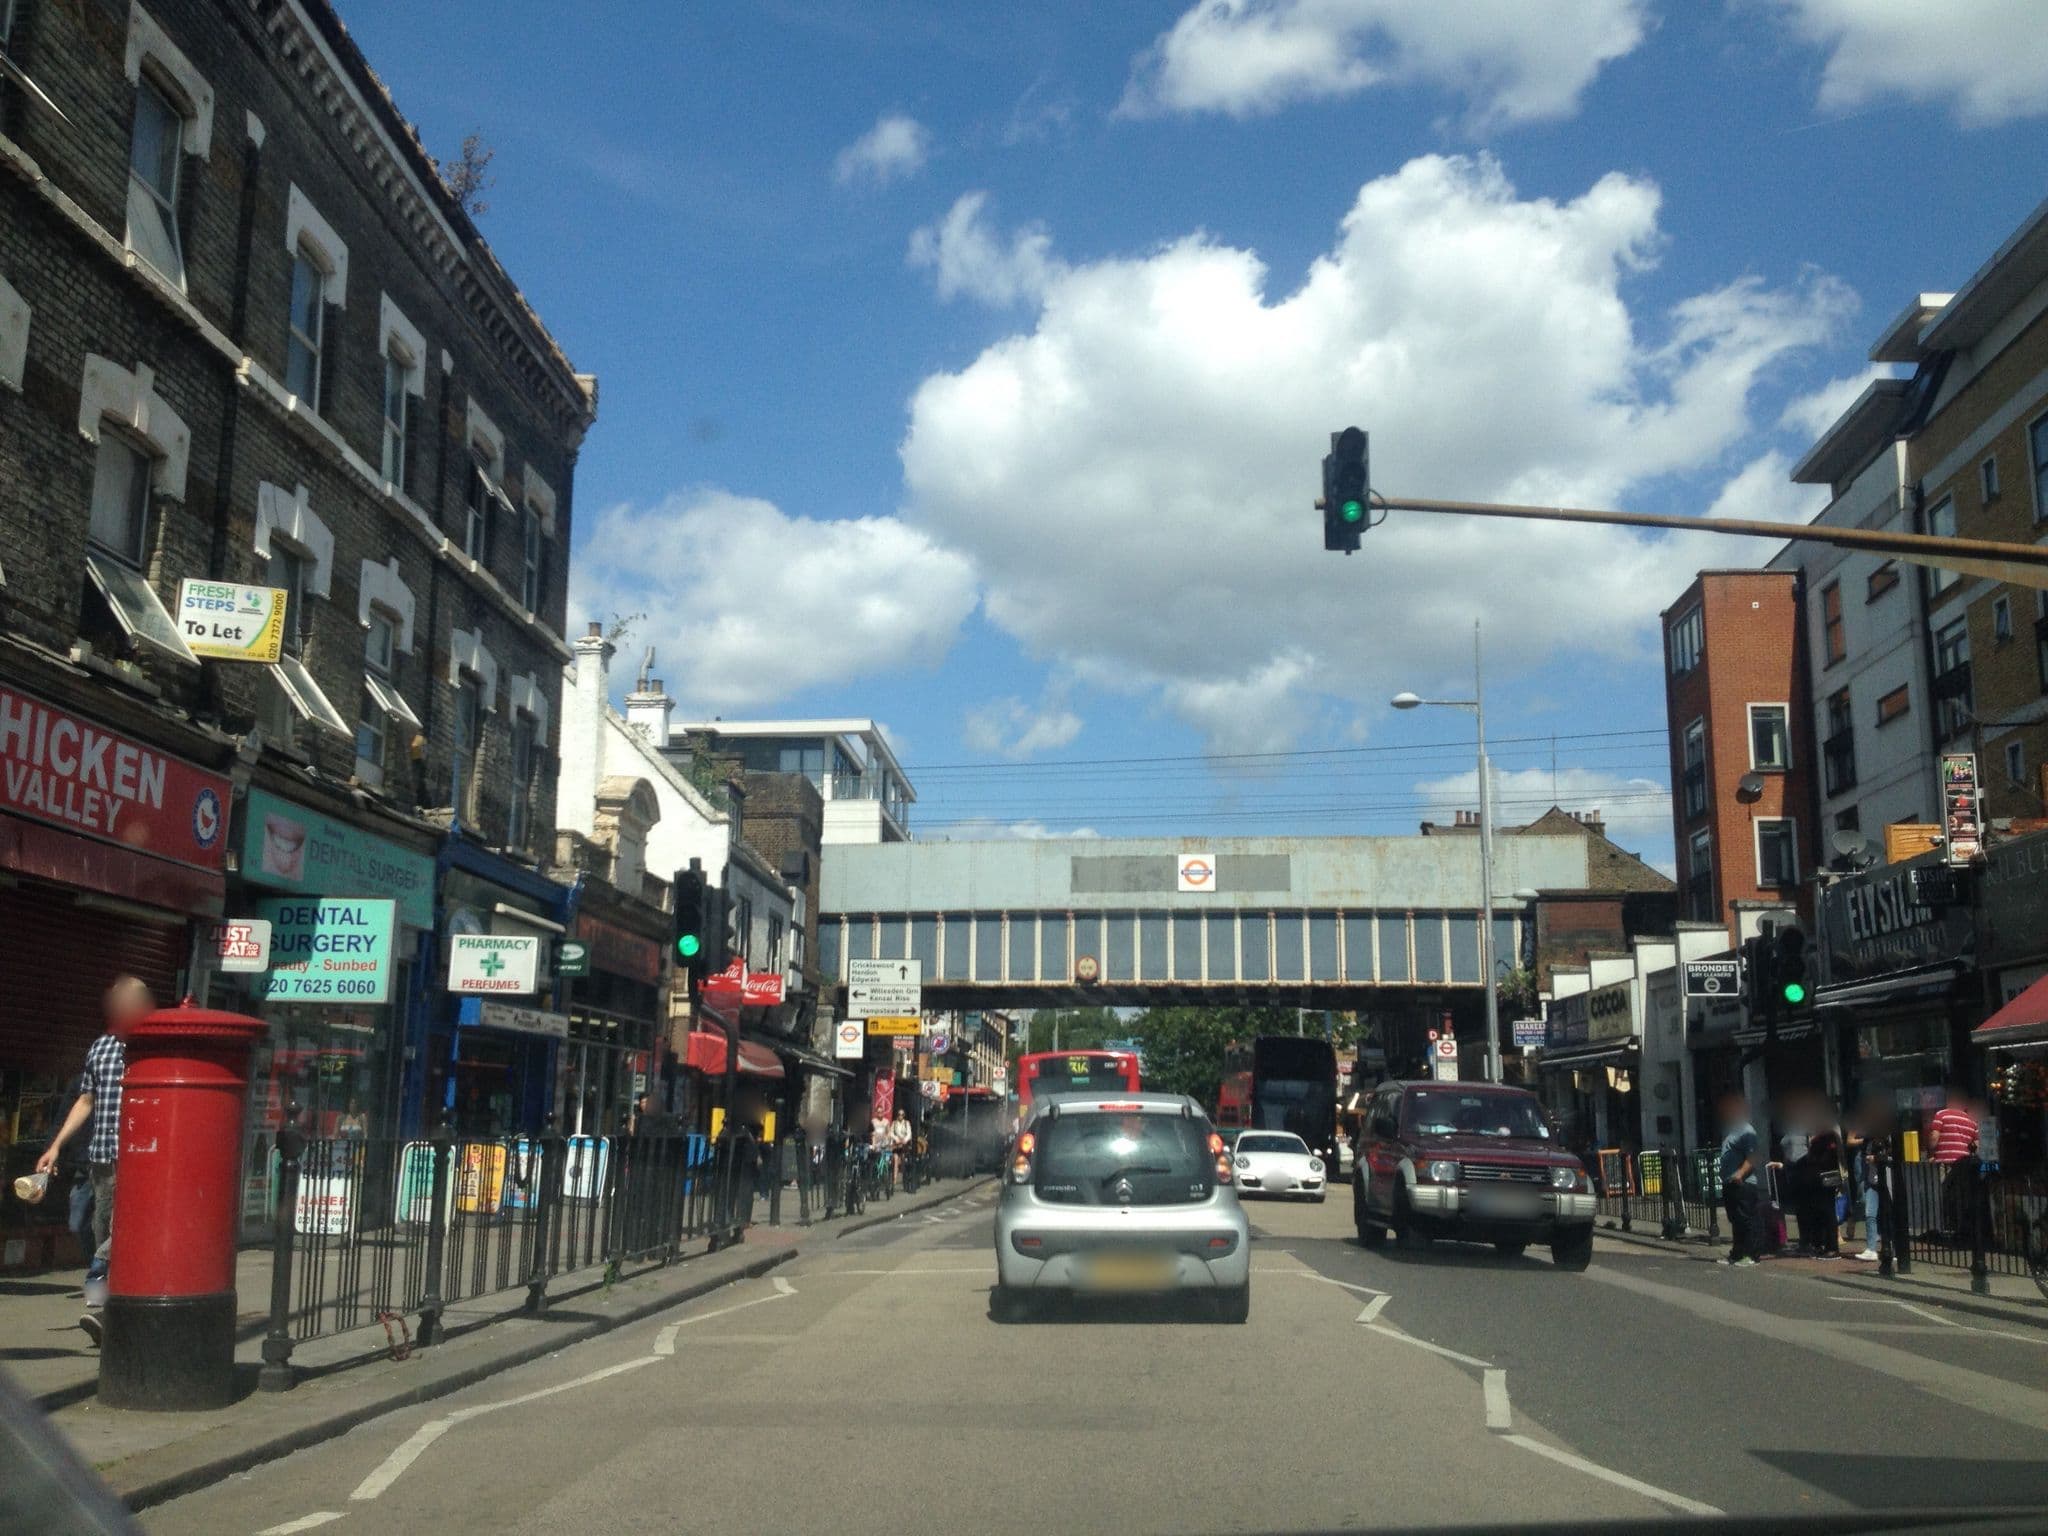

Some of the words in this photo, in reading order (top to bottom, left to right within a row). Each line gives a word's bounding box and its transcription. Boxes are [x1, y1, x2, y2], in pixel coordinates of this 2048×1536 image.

[188, 583, 236, 600] FRESH
[185, 596, 236, 613] STEPS
[274, 593, 285, 616] 9000
[185, 620, 206, 636] To
[212, 623, 242, 640] Let
[271, 618, 280, 641] 7372
[268, 642, 278, 660] 020
[5, 759, 124, 833] VALLEY
[309, 839, 367, 875] DENTAL
[279, 907, 369, 925] DENTAL
[210, 926, 251, 941] JUST
[219, 942, 247, 956] EAT
[271, 934, 377, 953] SURGERY
[459, 939, 532, 950] PHARMACY
[323, 959, 377, 972] Sunbed
[1688, 964, 1735, 973] BRONDES
[260, 979, 288, 994] 020
[294, 979, 332, 994] 7625
[337, 980, 376, 994] 6060
[462, 979, 520, 990] PERFUMES
